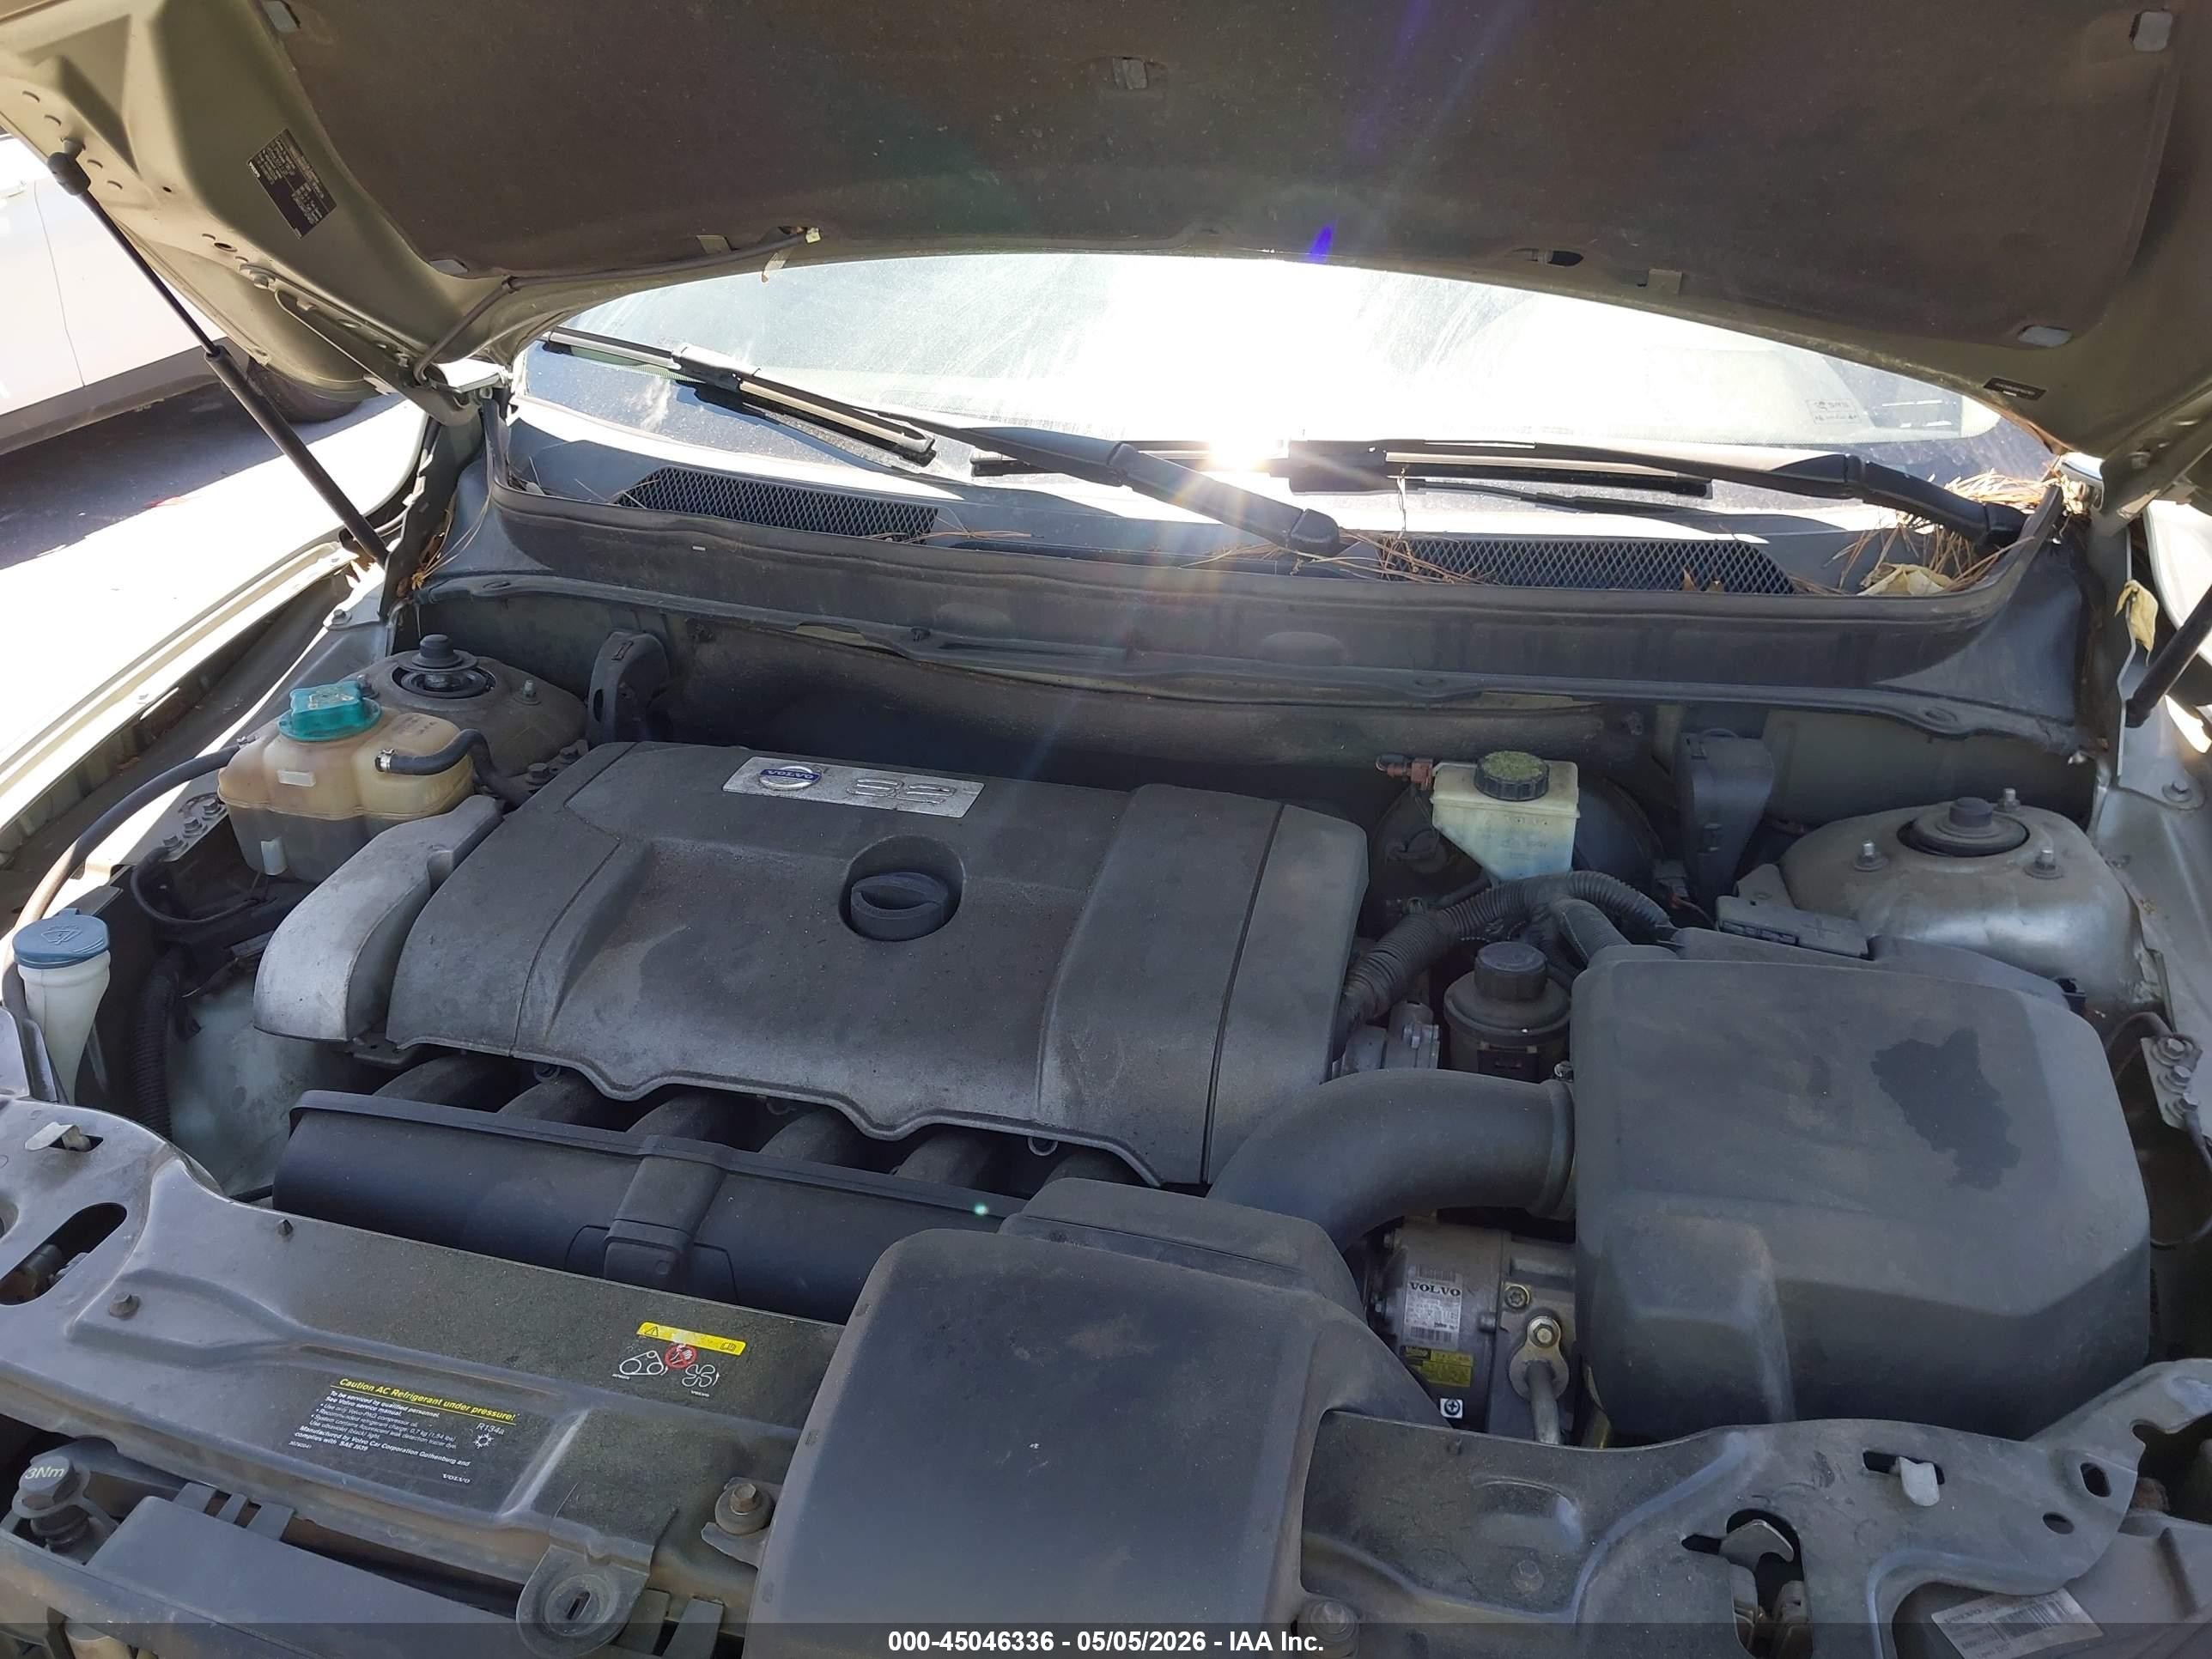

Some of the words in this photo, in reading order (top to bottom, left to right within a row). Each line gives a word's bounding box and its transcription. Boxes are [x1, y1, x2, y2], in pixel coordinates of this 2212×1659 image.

[767, 769, 814, 779] VOLVO
[1409, 1281, 1462, 1297] VOLVO
[338, 1398, 356, 1407] Volvo
[339, 1378, 374, 1391] Caution
[375, 1386, 391, 1395] AC
[391, 1389, 443, 1406] Refrigerant
[443, 1400, 471, 1411] under
[470, 1407, 516, 1420] pressure!
[347, 1395, 373, 1403] serviced
[476, 1422, 505, 1435] R134a
[299, 1425, 343, 1439] Manufactured
[380, 1443, 419, 1455] Corporation
[418, 1451, 457, 1464] Gothenburg
[25, 1466, 65, 1480] 3Nm
[442, 1474, 471, 1484] VOLVO
